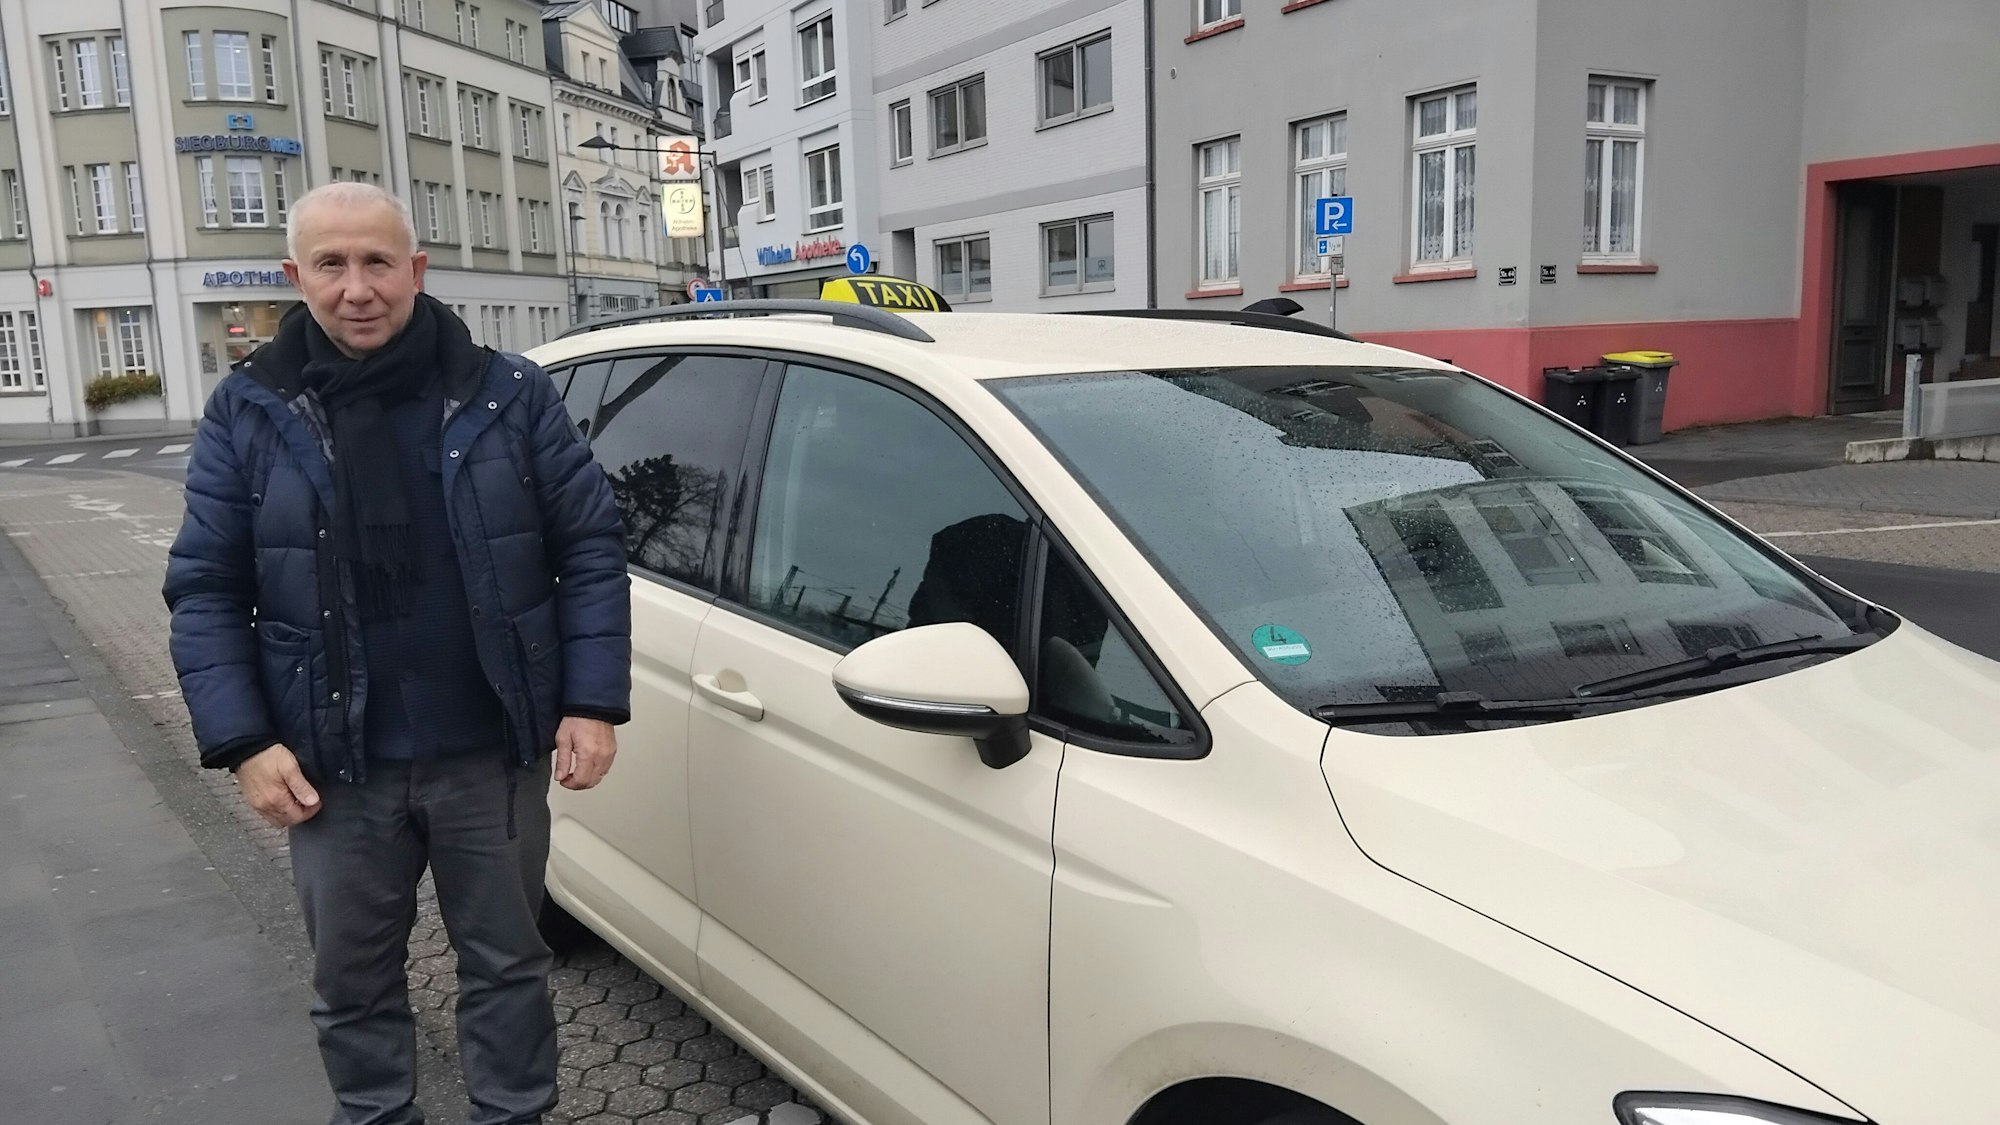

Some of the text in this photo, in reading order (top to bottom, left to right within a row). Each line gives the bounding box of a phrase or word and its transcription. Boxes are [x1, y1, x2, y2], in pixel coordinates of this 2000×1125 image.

[1324, 202, 1345, 231] P
[756, 236, 841, 266] Wilhelm Apotheke
[203, 271, 291, 287] APOTHE
[856, 282, 928, 308] TAXI
[1270, 626, 1287, 644] 4
